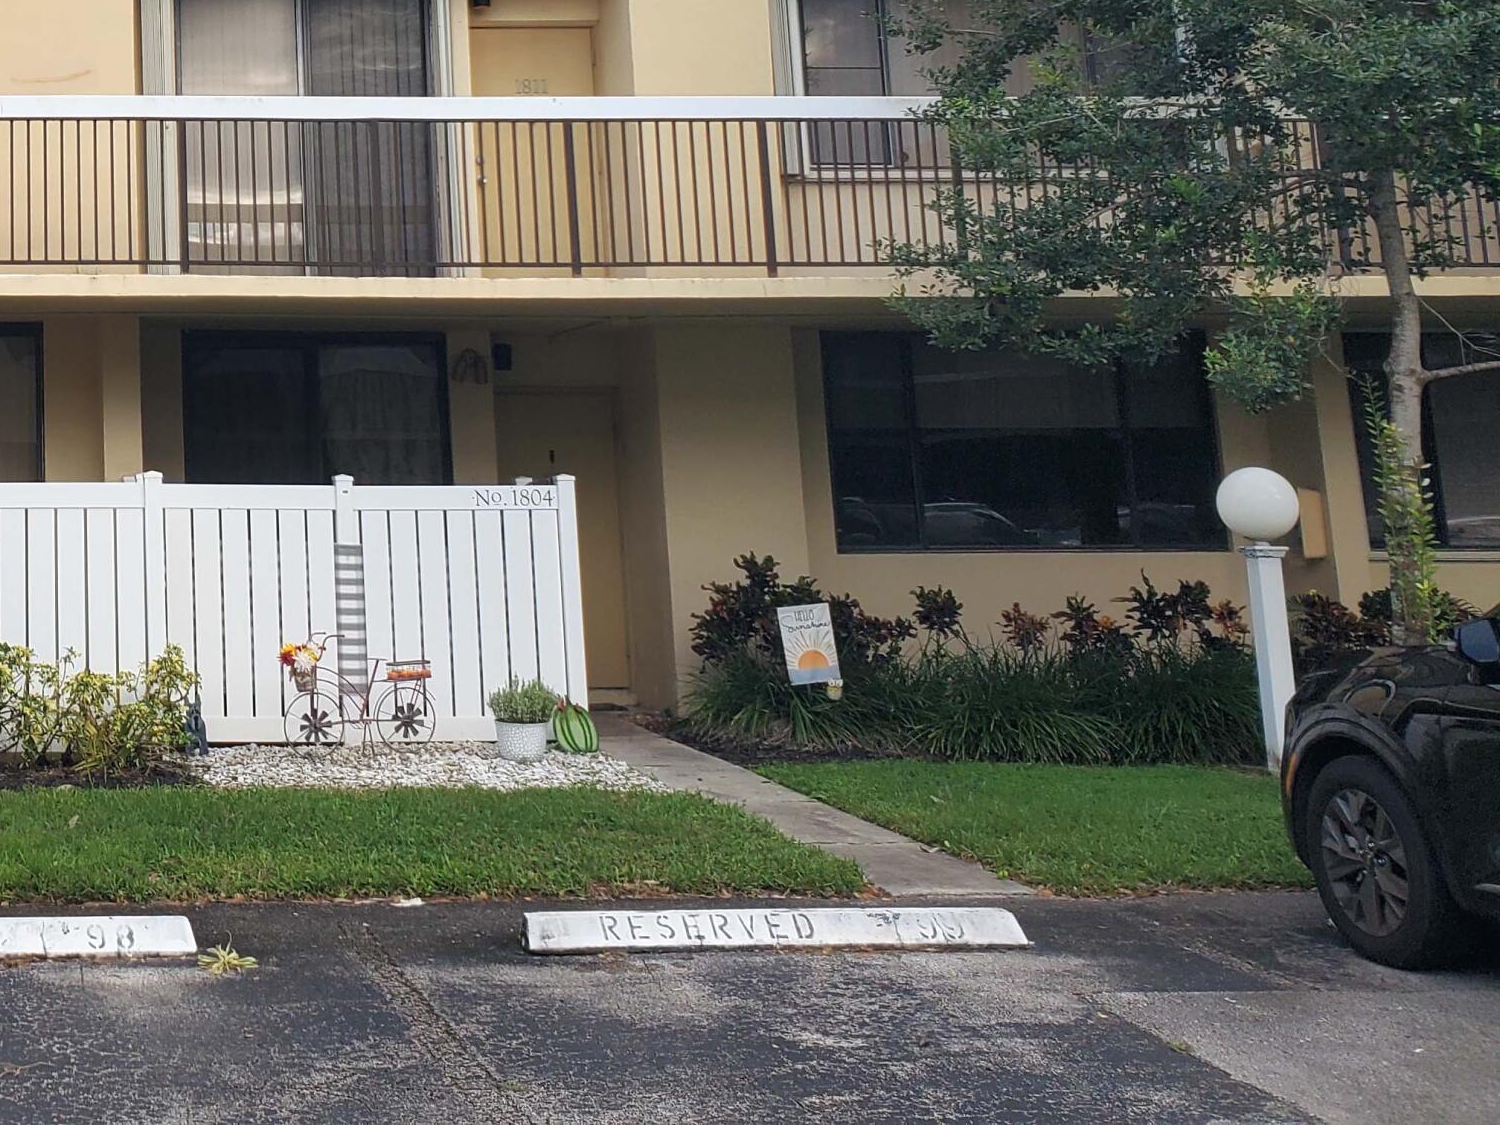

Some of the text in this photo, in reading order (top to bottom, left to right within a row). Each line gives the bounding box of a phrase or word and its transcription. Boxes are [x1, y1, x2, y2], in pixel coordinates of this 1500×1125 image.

[511, 488, 553, 507] 1804
[794, 609, 814, 622] HELLO
[599, 912, 817, 941] RESERVED
